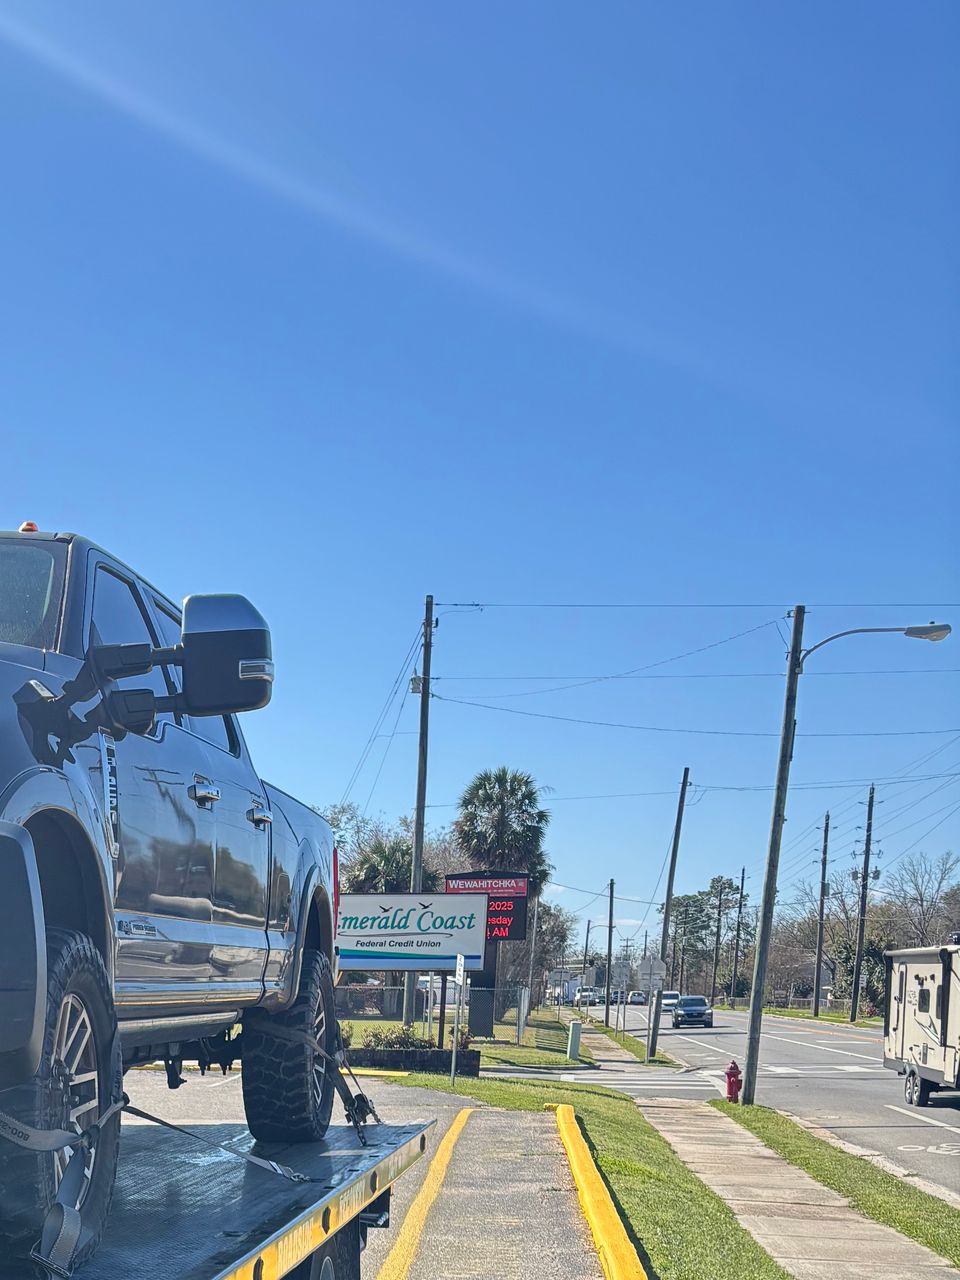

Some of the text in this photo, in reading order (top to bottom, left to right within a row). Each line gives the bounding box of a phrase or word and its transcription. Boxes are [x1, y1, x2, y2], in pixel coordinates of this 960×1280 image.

[449, 880, 516, 888] WEWAHITCHKA
[489, 901, 513, 911] 2025
[338, 907, 476, 932] merald Coast
[488, 916, 513, 926] sday
[492, 927, 509, 937] AM
